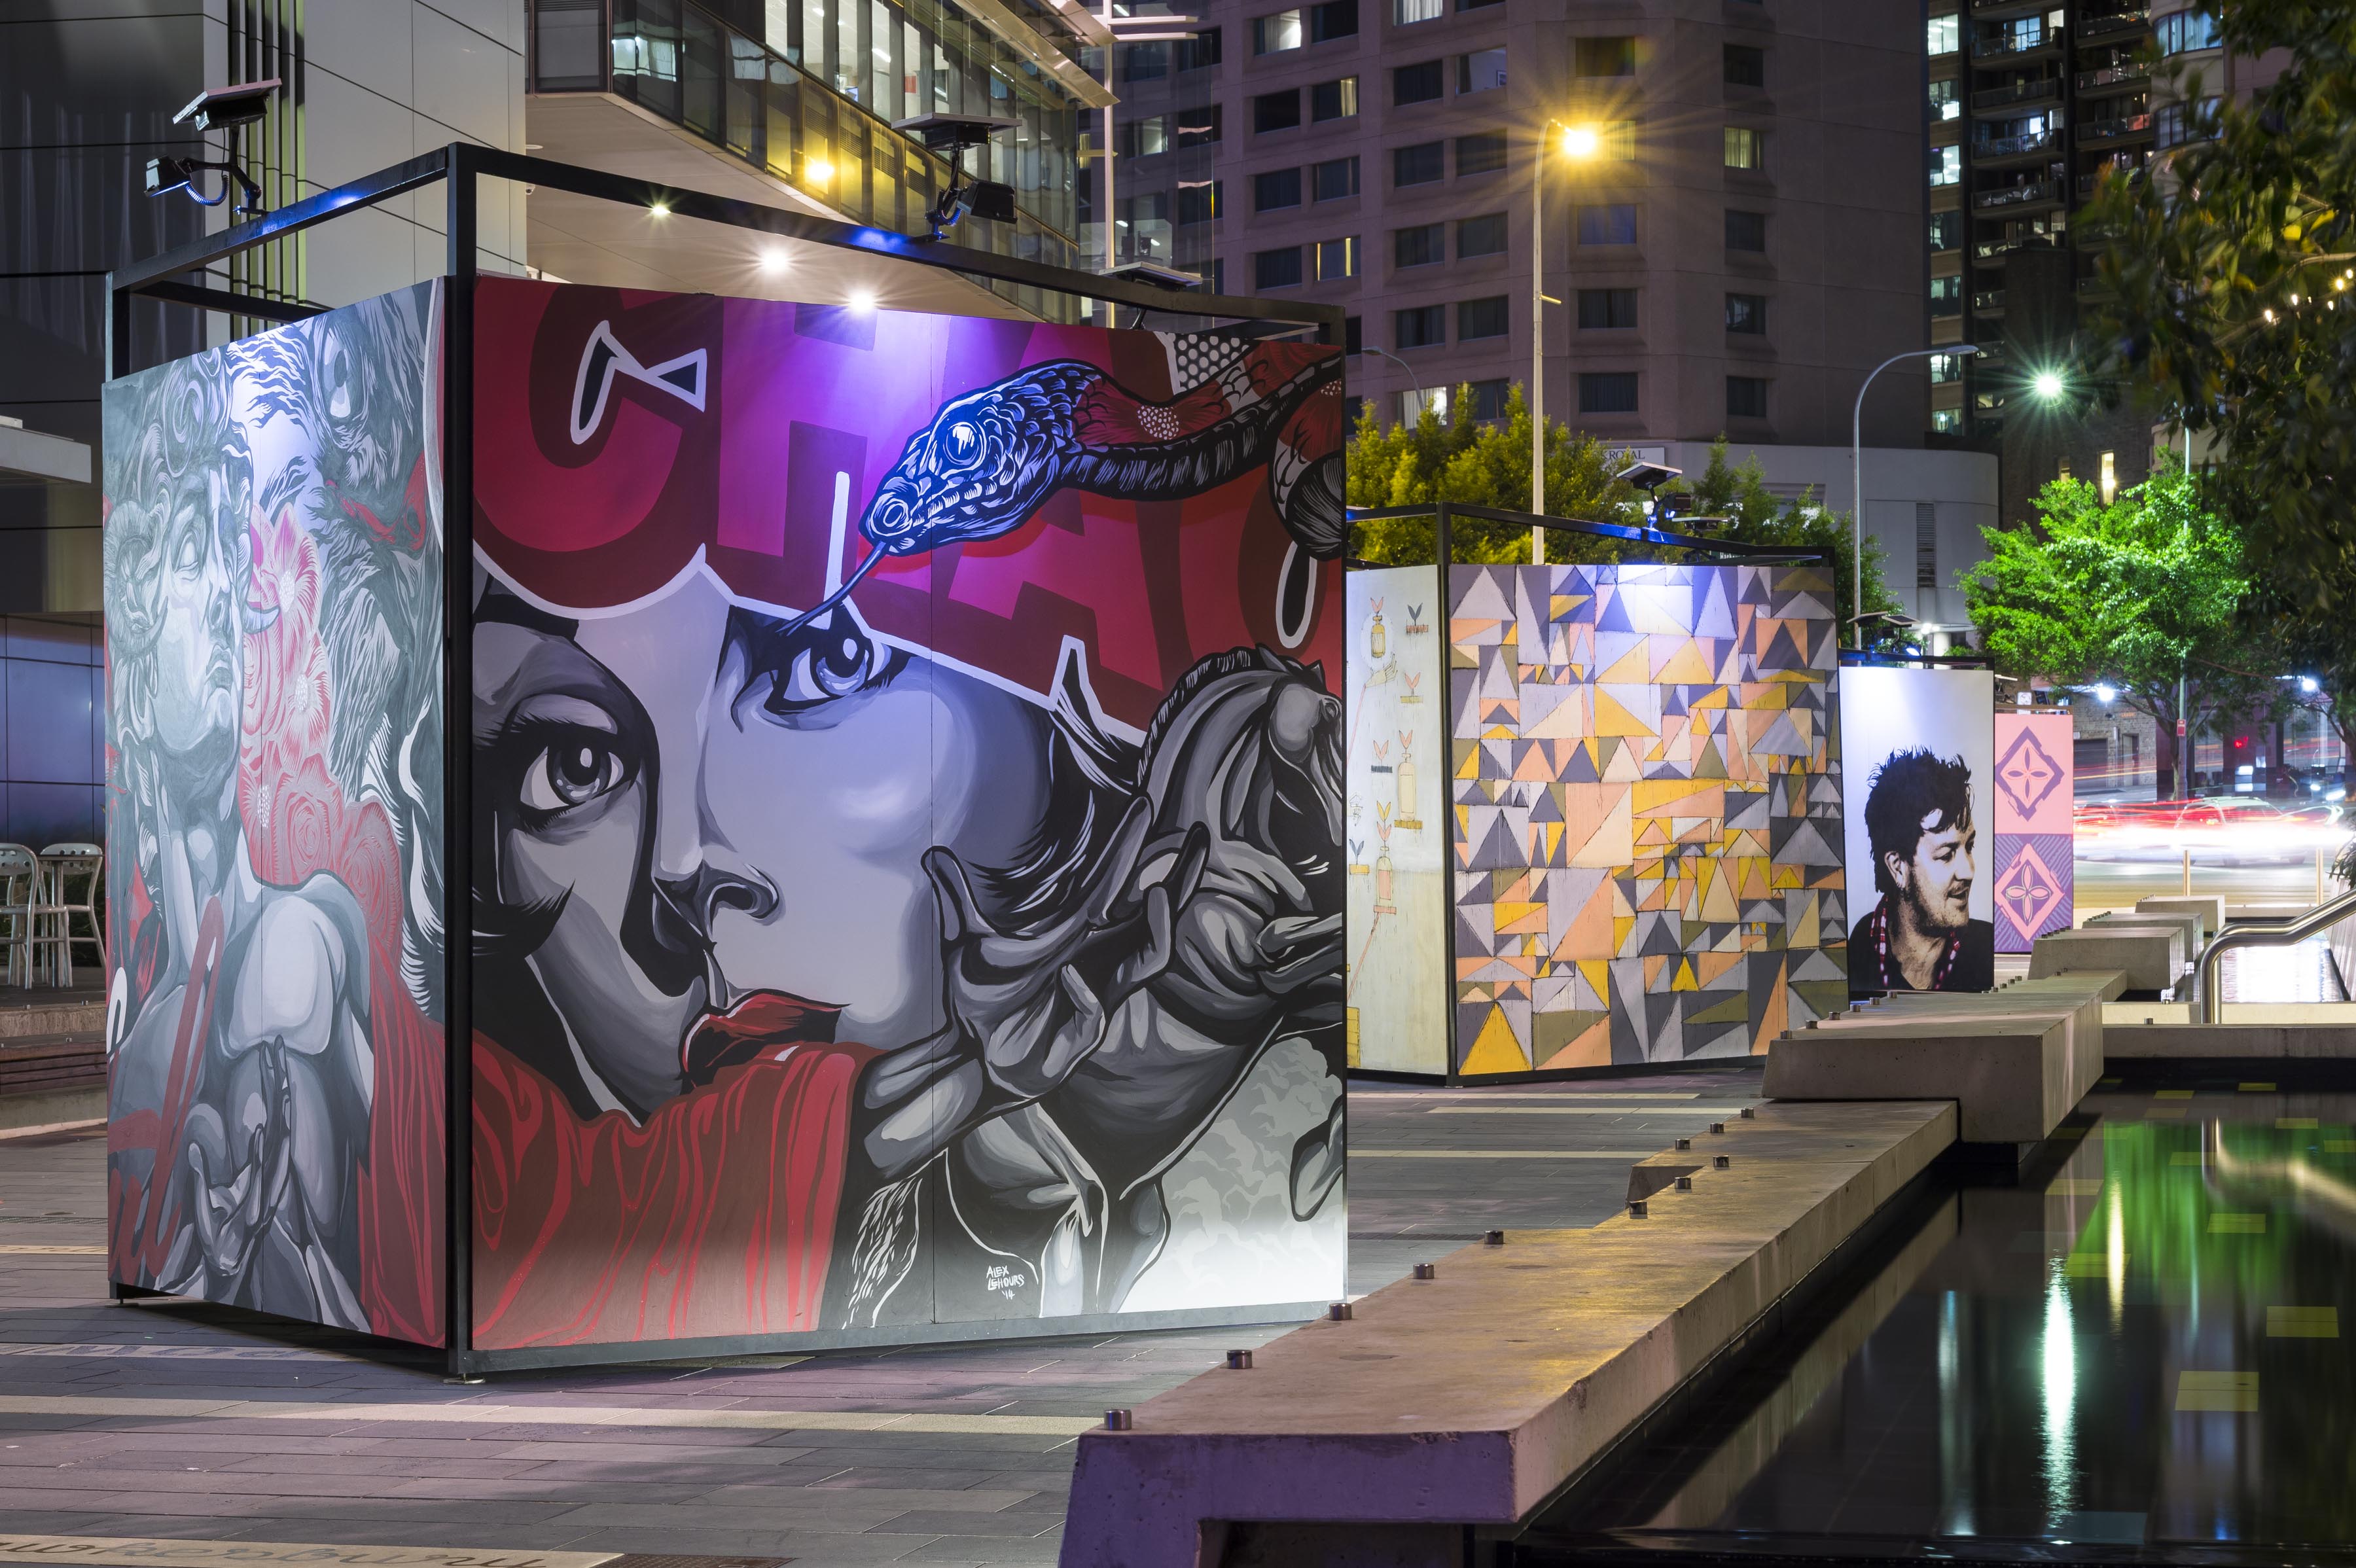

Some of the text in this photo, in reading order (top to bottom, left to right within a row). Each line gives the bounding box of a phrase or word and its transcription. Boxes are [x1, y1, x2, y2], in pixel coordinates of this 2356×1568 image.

[986, 1265, 1009, 1279] ALEX
[988, 1274, 1025, 1291] LEHOURS
[1001, 1289, 1016, 1300] '14
